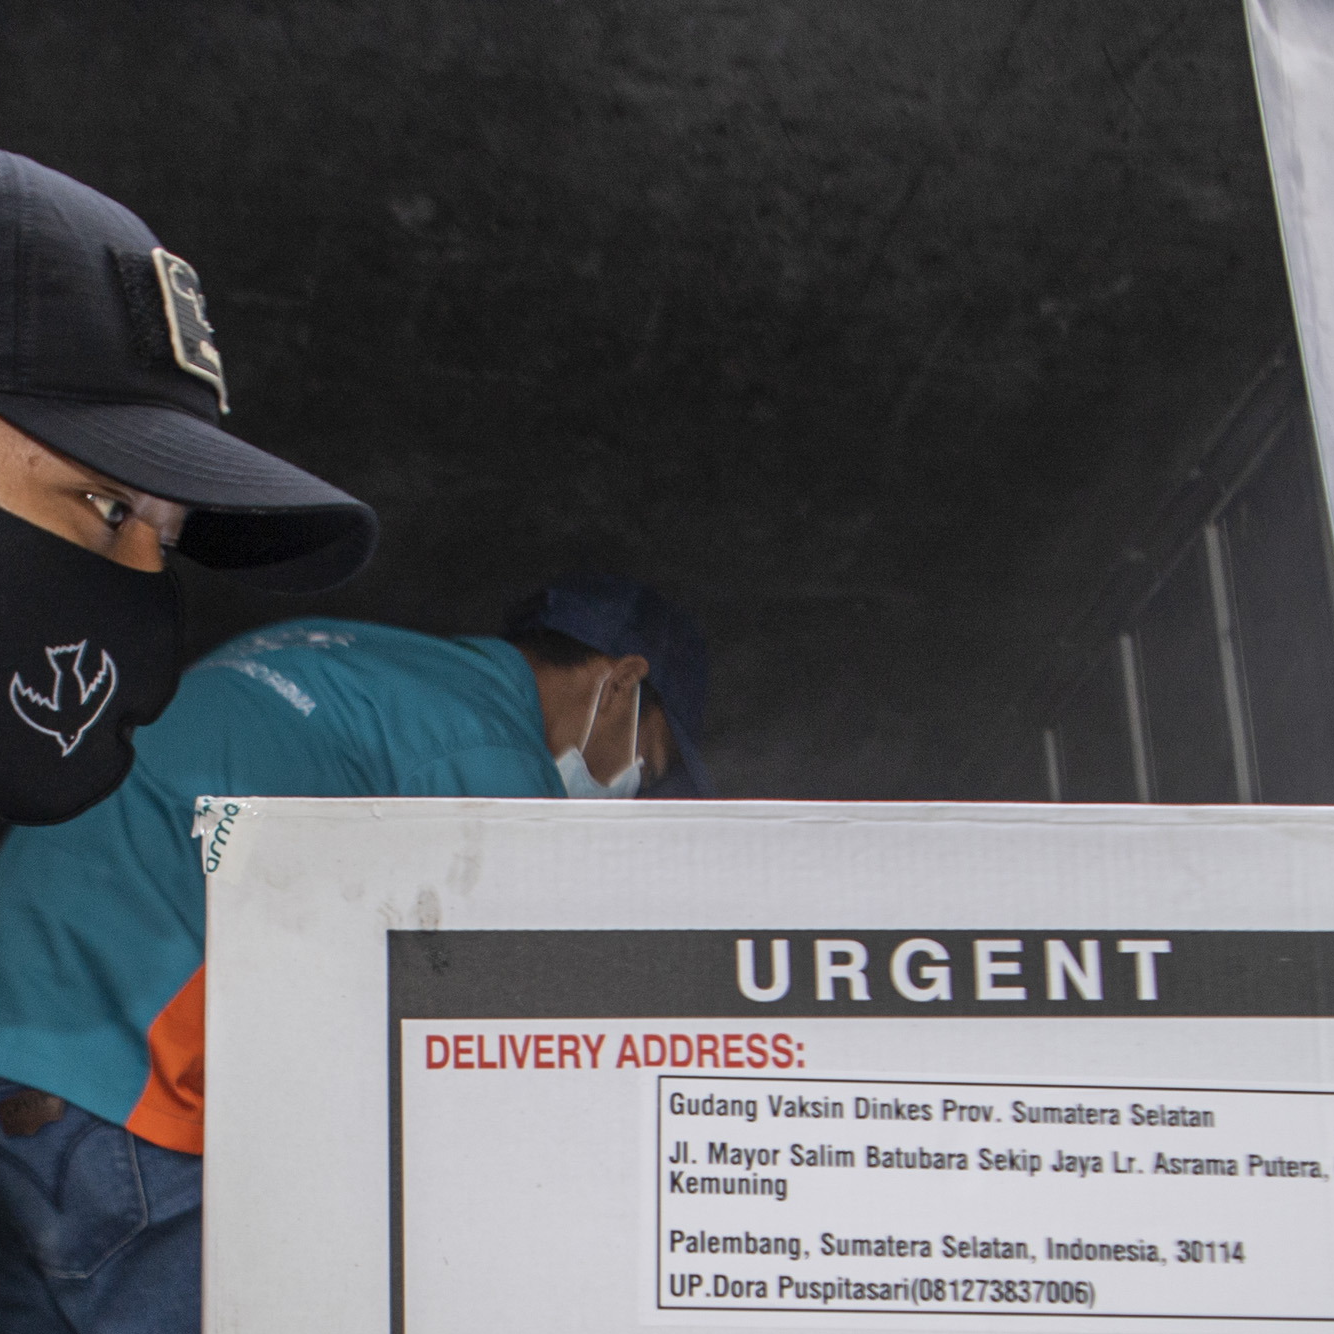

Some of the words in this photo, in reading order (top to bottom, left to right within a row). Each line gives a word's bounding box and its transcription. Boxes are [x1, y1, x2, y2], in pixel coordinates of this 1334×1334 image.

[736, 938, 1173, 1003] URGENT
[425, 1034, 608, 1072] DELIVERY
[614, 1033, 807, 1070] ADDRESS:
[668, 1092, 758, 1123] Gudang
[767, 1094, 845, 1120] Vaksin
[854, 1096, 933, 1122] Dinkes
[942, 1098, 1003, 1124] Prov.
[1011, 1100, 1122, 1127] Sumatera
[1129, 1103, 1216, 1129] Selatan
[668, 1141, 698, 1165] Jl.
[707, 1141, 781, 1171] Mayor
[790, 1143, 856, 1168] Salim
[866, 1145, 969, 1171] Batubara
[978, 1147, 1042, 1177] Sekip
[1050, 1149, 1104, 1178] Jaya
[1112, 1151, 1144, 1174] Lr.
[1153, 1151, 1239, 1177] Asrama
[1247, 1153, 1330, 1183] Putera,
[668, 1170, 788, 1202] Kemuning
[668, 1229, 811, 1261] Palembang,
[820, 1232, 933, 1259] Sumatera
[941, 1234, 1038, 1264] Selatan,
[1046, 1237, 1168, 1266] Indonesia,
[1175, 1239, 1246, 1264] 30114
[668, 1273, 768, 1299] UP.Dora
